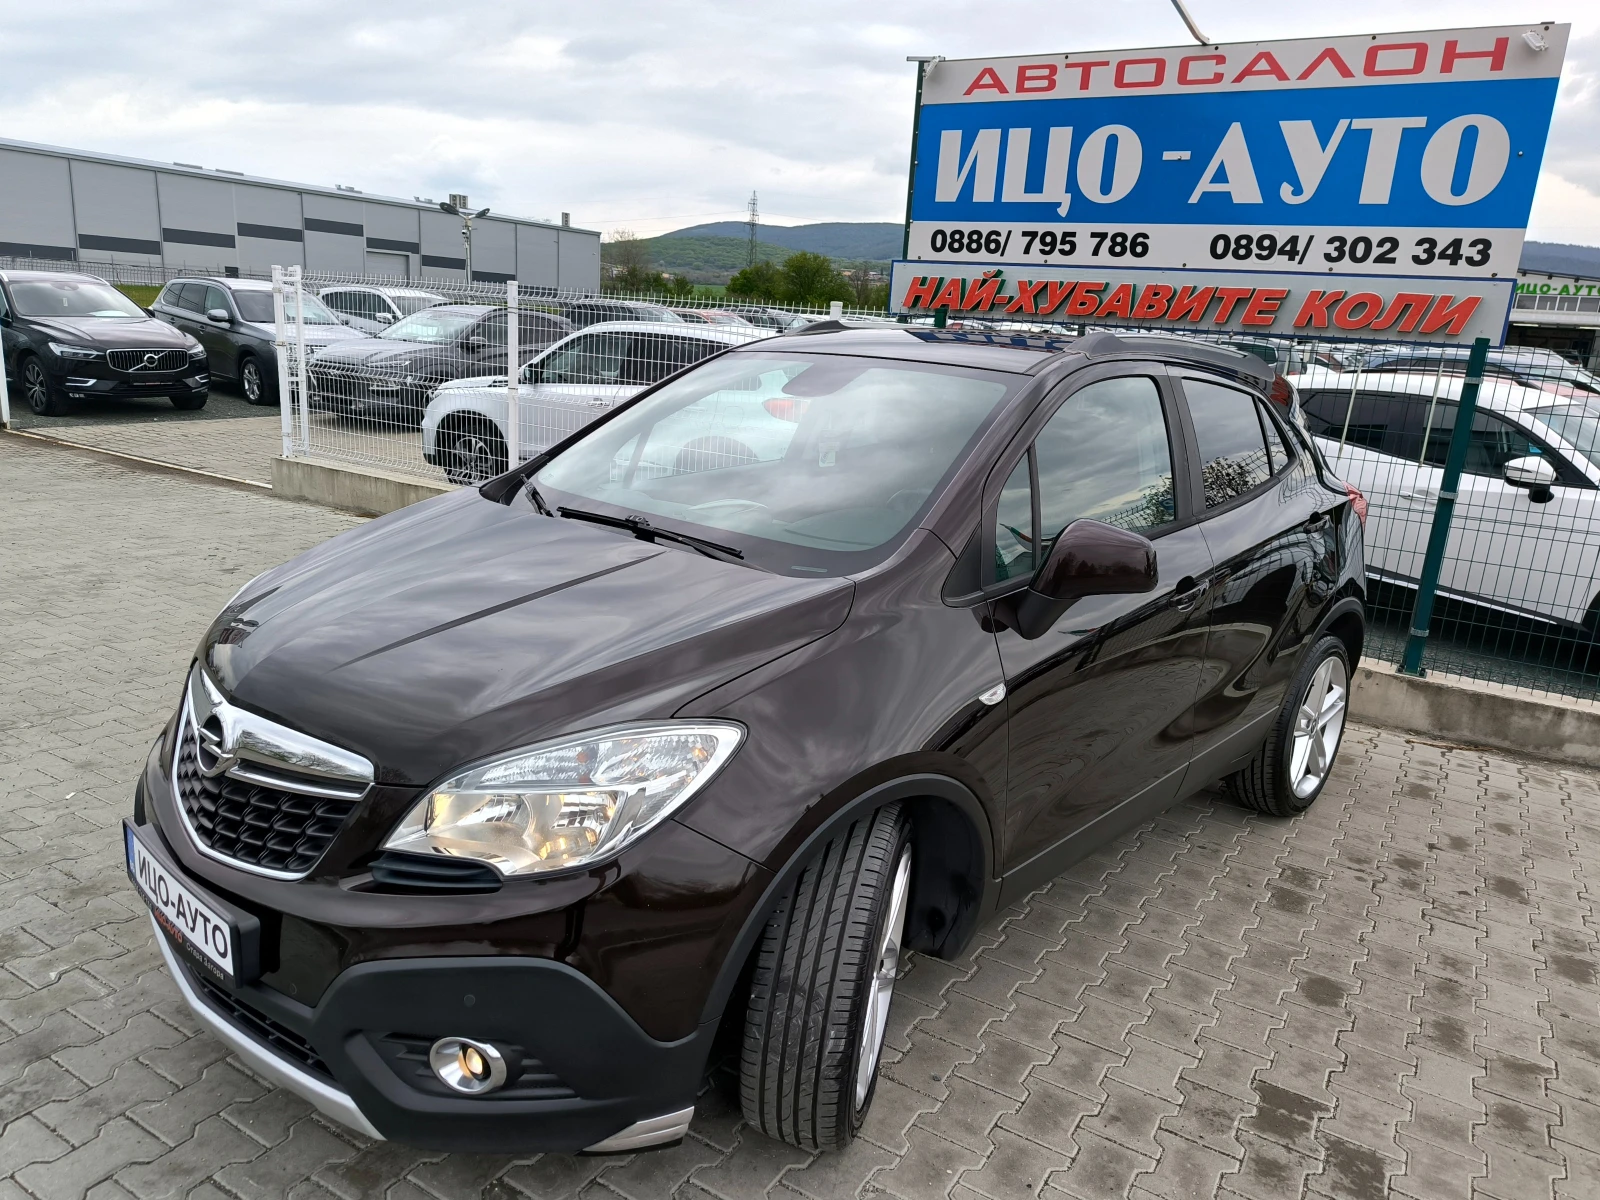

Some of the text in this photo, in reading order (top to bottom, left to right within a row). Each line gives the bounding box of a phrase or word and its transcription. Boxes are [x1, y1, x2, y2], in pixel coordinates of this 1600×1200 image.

[963, 37, 1509, 97] АВТОСАЛОН
[930, 229, 1493, 267] 0886/ 795 786 0894/ 302 343
[902, 268, 1484, 336] НАЙ-ХУБАВИТЕ КОЛИ
[1514, 283, 1600, 296] ИЦО-АУТ
[137, 848, 229, 960] ИЦО-АУТО
